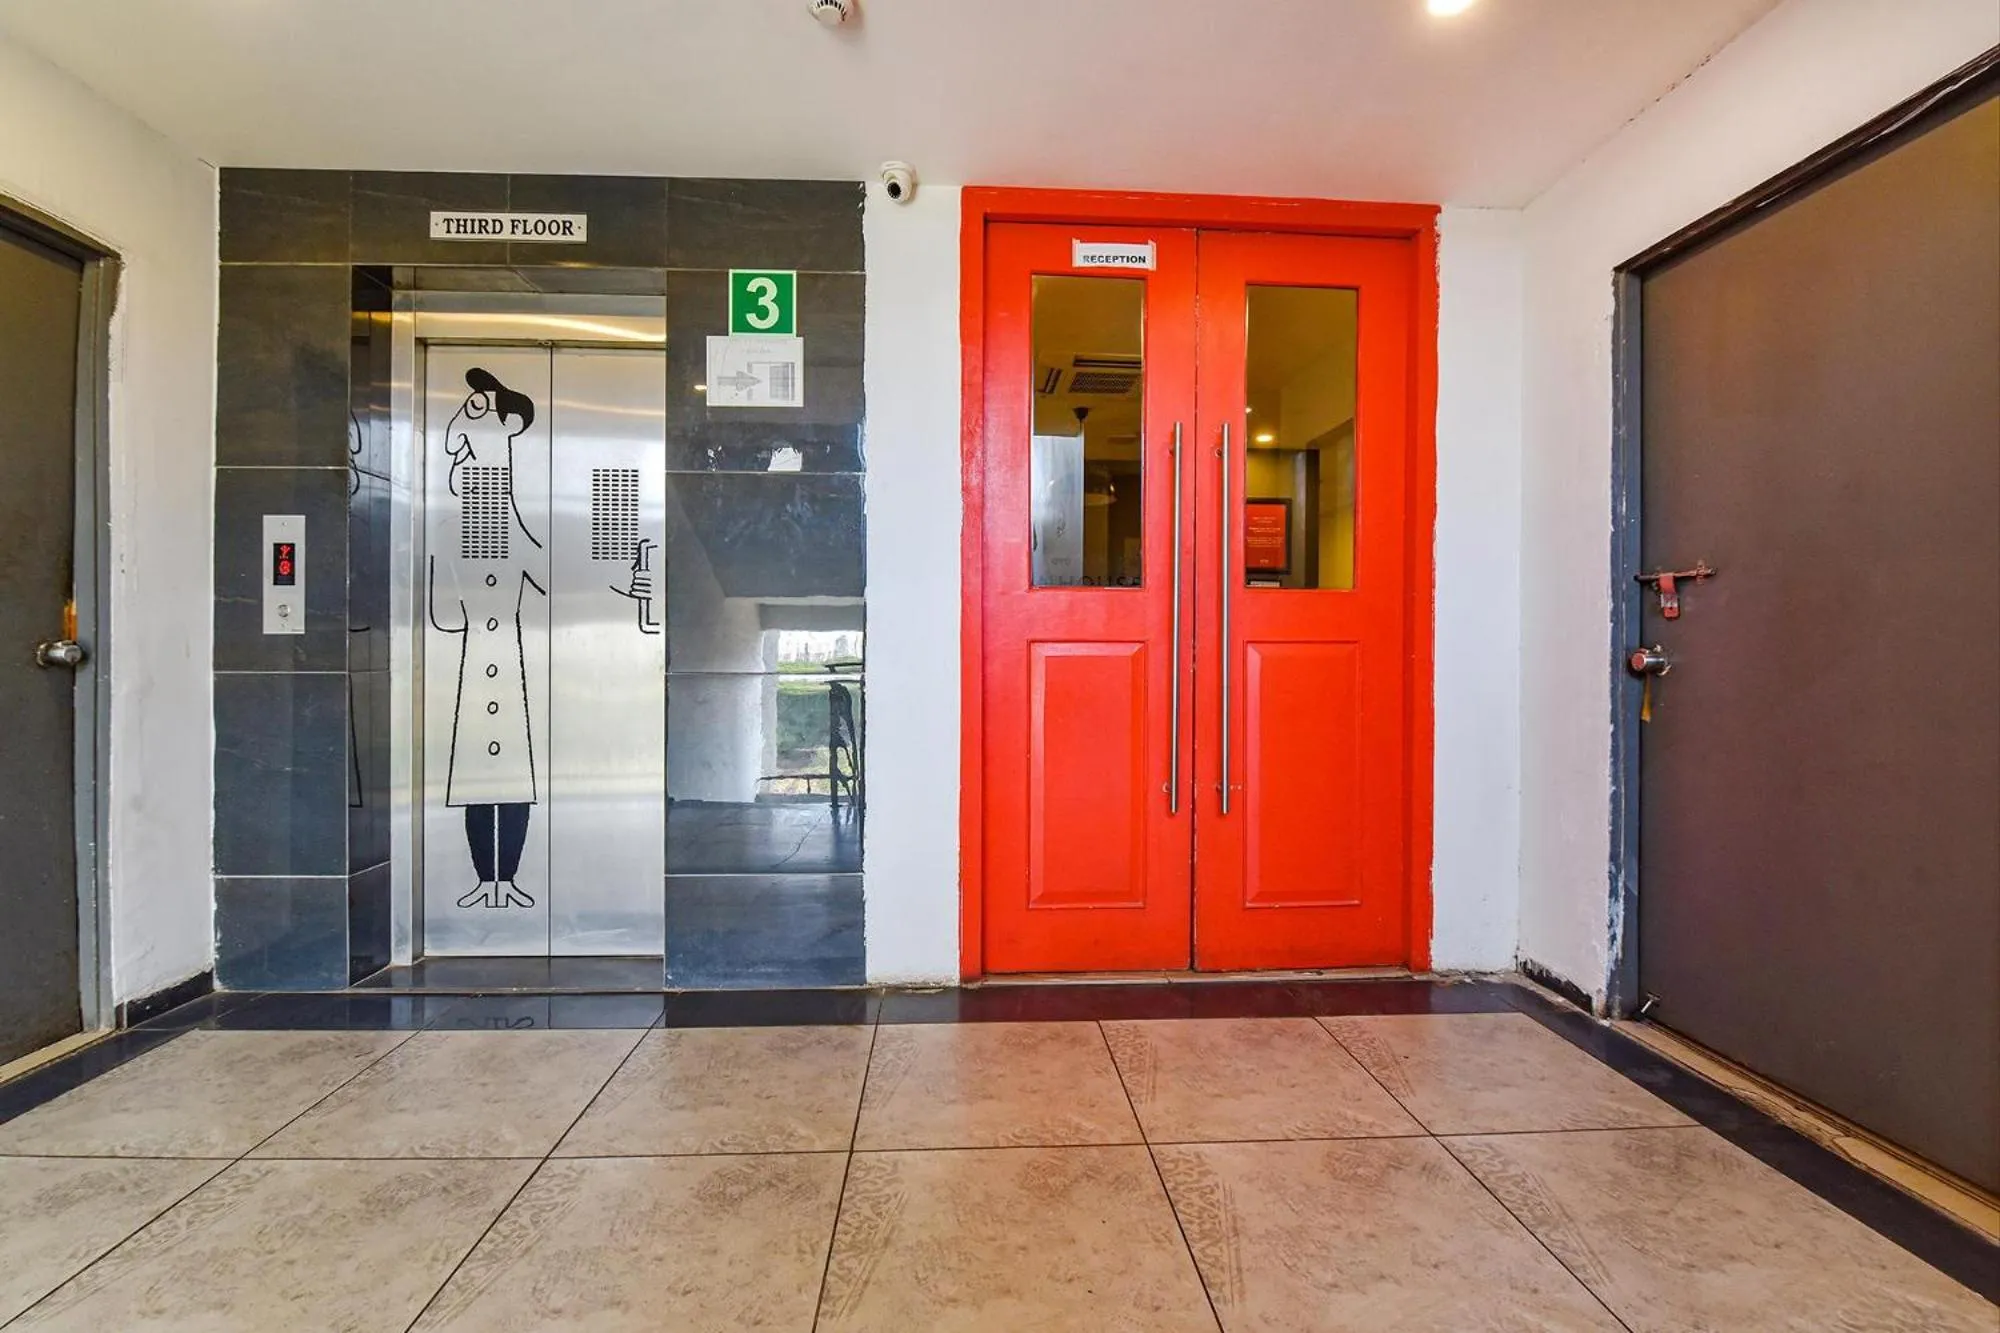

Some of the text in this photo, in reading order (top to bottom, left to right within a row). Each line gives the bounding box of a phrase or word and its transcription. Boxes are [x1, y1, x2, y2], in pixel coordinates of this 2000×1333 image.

[442, 218, 574, 236] THIRD FLOOR
[1082, 255, 1147, 264] RECEPTION
[745, 276, 780, 330] 3
